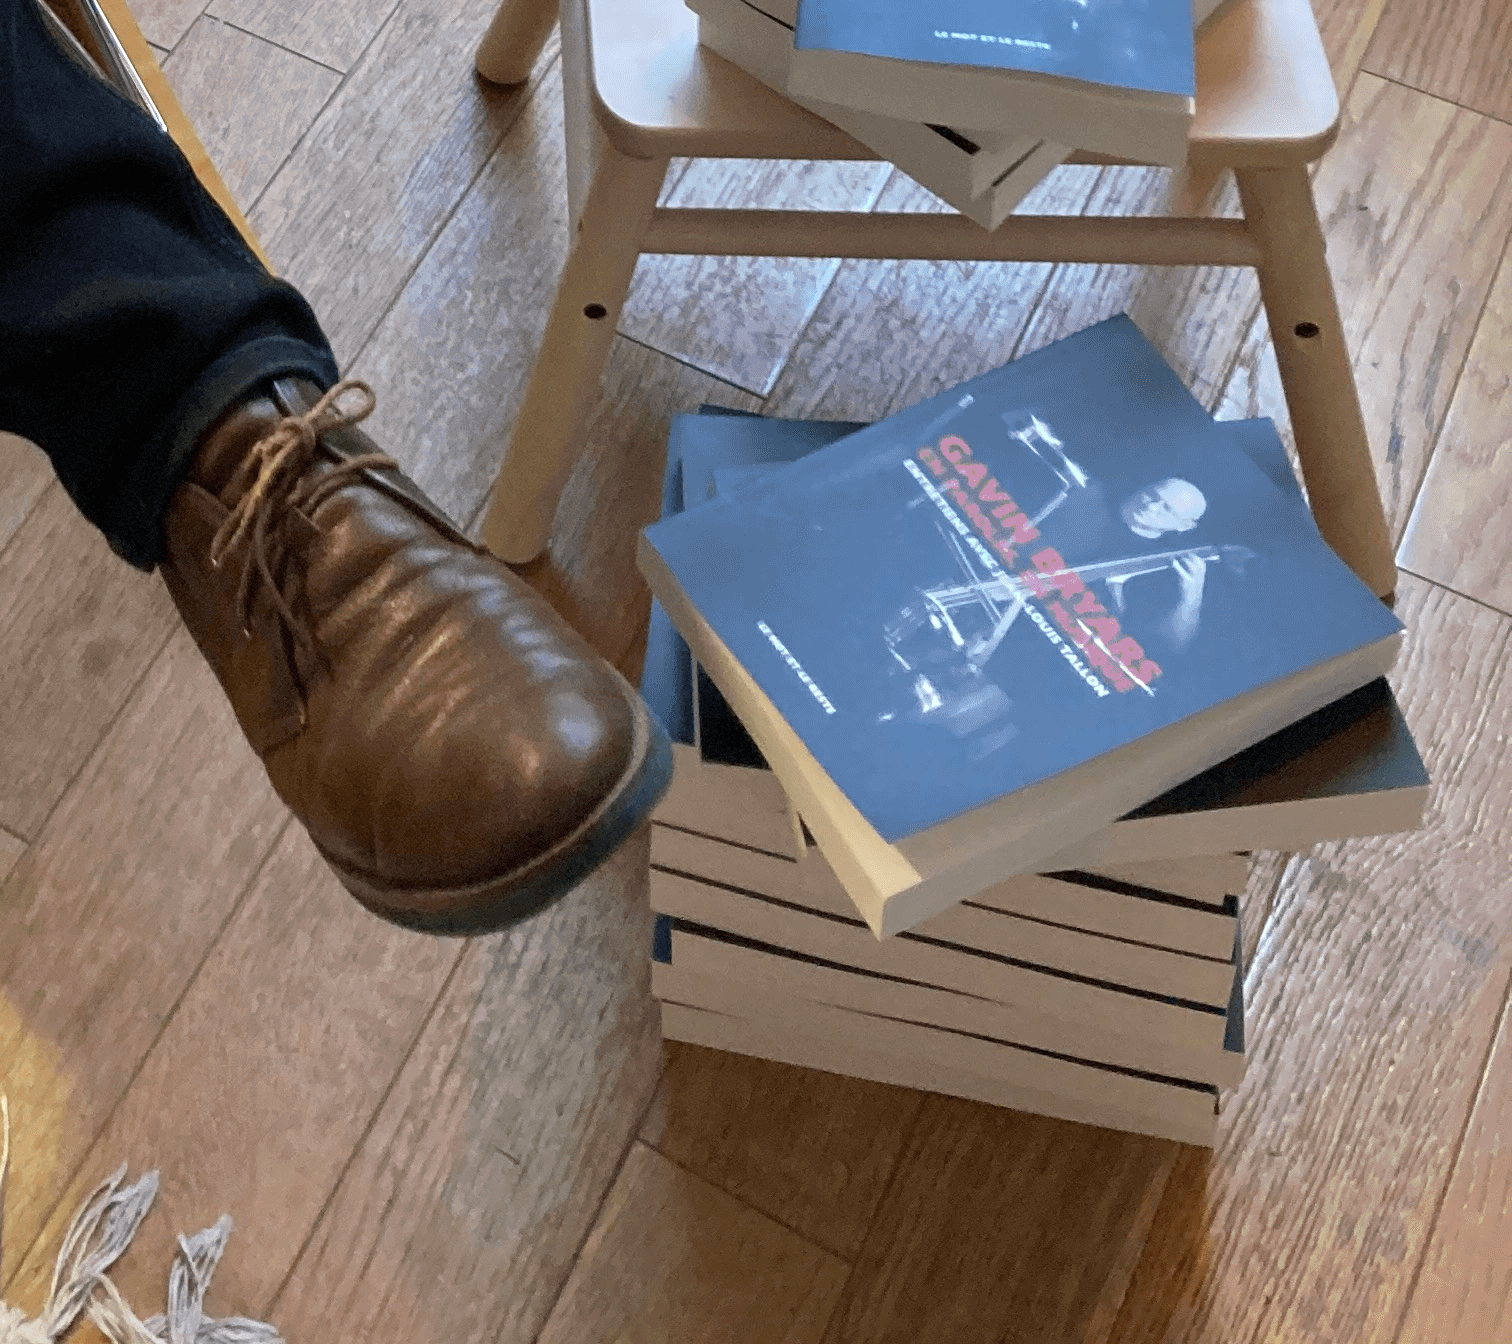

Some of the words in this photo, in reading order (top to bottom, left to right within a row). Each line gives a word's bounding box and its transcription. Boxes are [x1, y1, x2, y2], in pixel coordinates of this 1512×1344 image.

[903, 458, 970, 536] ENTRETIENS
[965, 536, 1000, 570] AVEC
[1059, 643, 1110, 698] TALLON
[939, 434, 1040, 545] GAVIN
[1031, 547, 1162, 685] BRYARS
